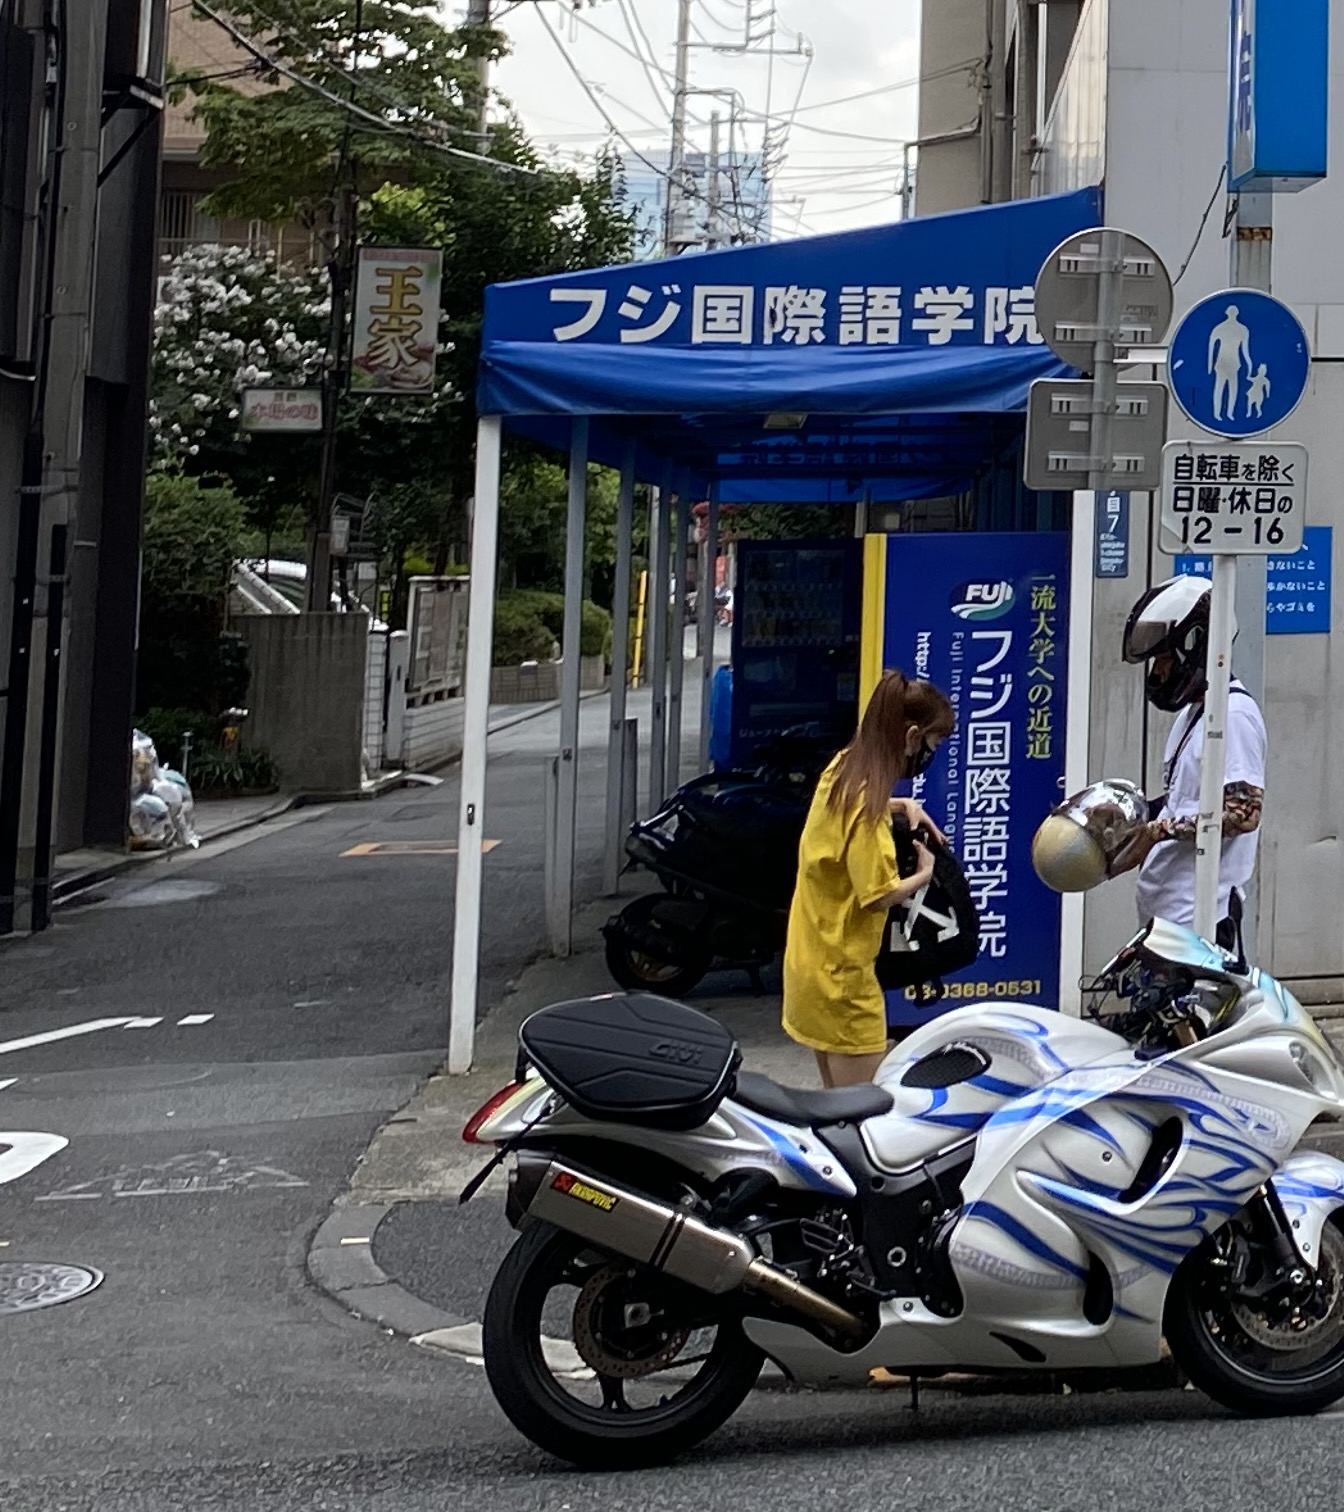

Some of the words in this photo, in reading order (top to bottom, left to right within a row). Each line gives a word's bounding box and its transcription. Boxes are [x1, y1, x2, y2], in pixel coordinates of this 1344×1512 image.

[367, 266, 423, 368] 王家
[549, 284, 1045, 346] フジ国際語学院
[1174, 454, 1294, 481] 自転車を除く
[949, 632, 964, 662] Fuji
[1026, 573, 1057, 760] 一流大学への近道
